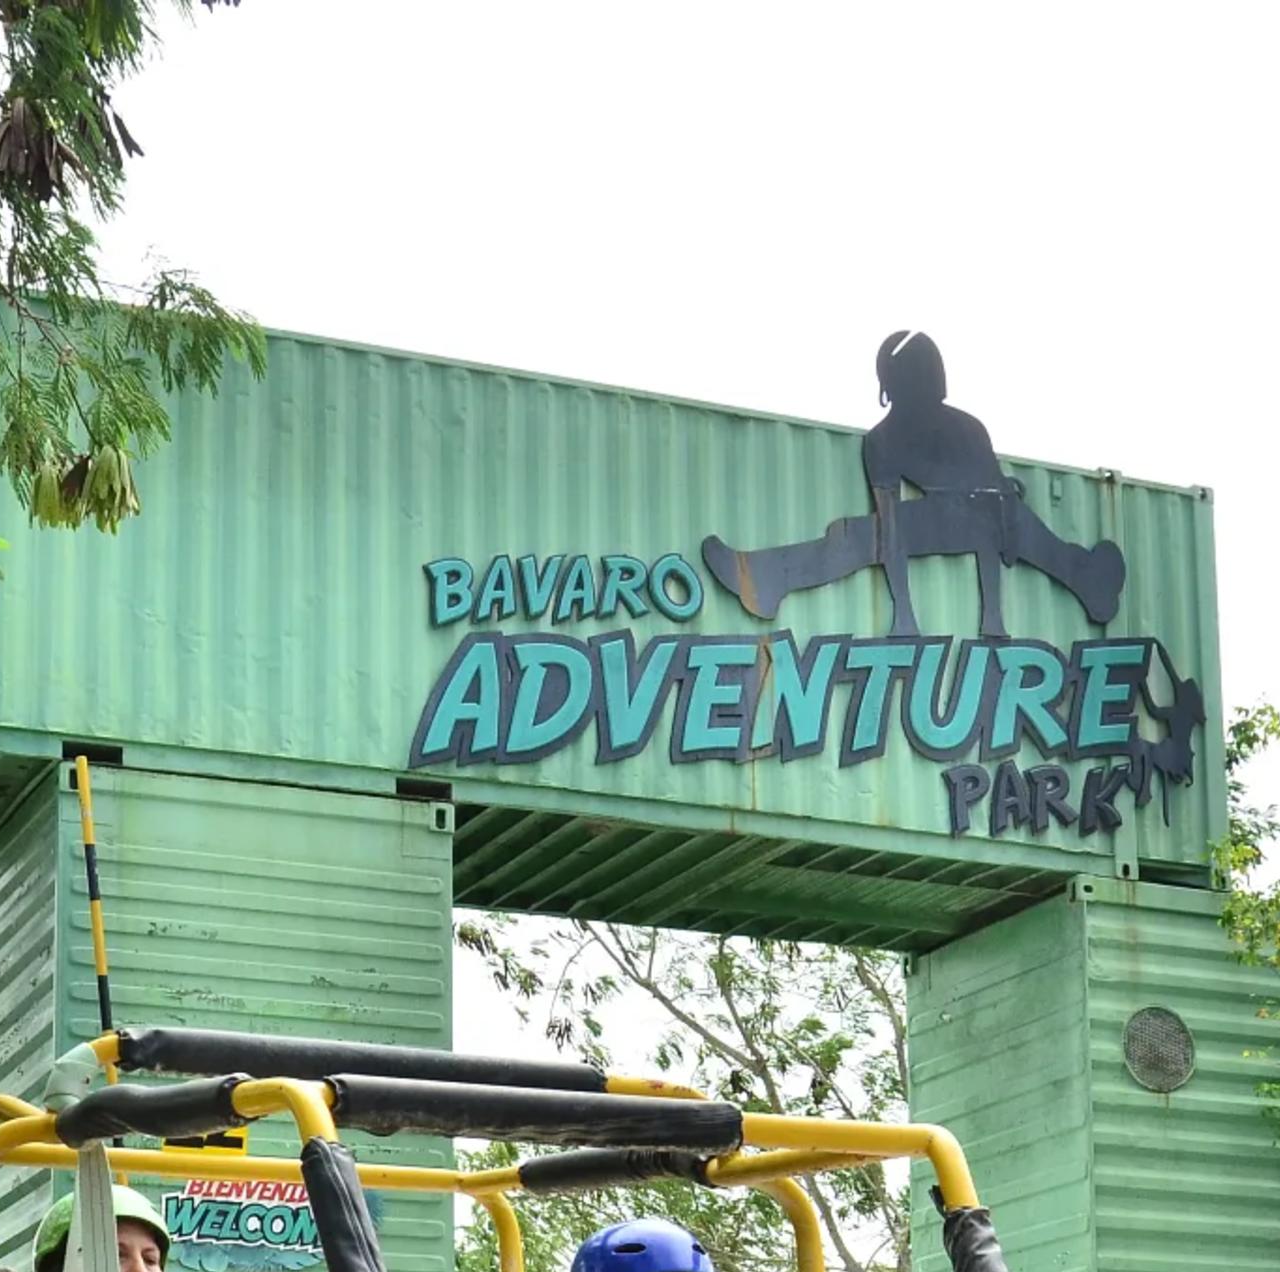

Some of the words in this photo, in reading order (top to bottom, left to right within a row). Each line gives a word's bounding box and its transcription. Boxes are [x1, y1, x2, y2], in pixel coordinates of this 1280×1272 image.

[425, 552, 705, 628] BAVARO
[409, 630, 1157, 769] ADVENTURE
[941, 759, 1131, 839] PARK
[164, 1196, 321, 1249] WELCOM
